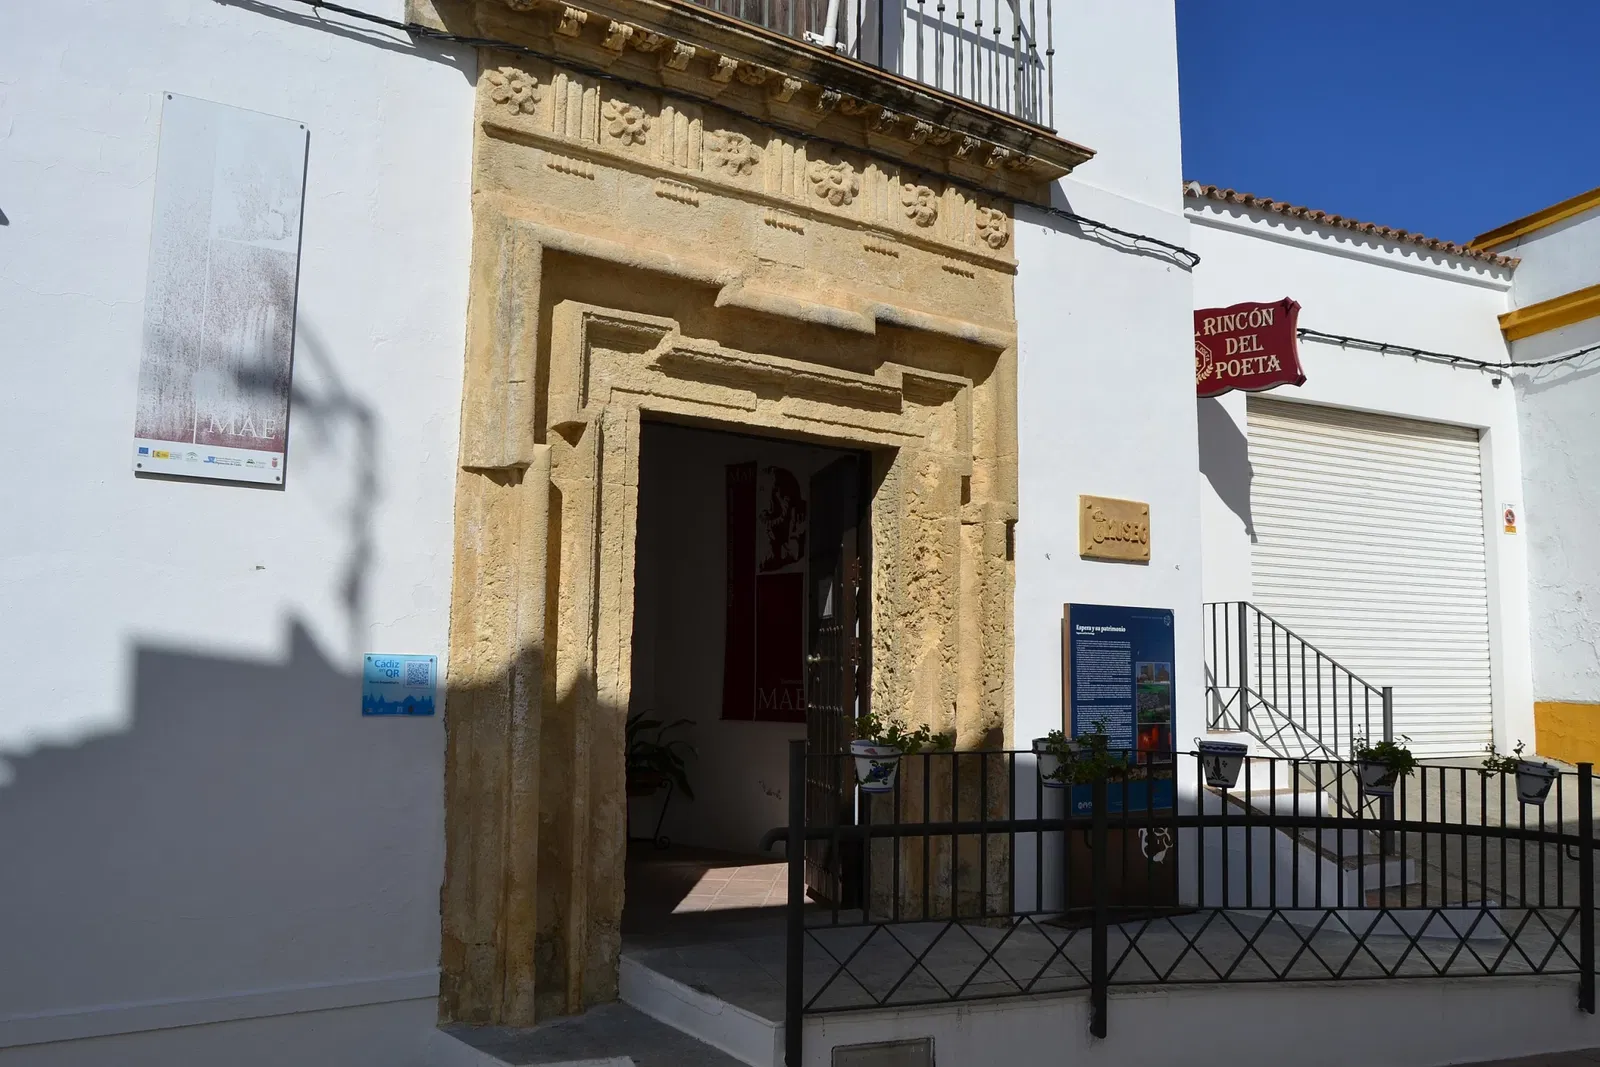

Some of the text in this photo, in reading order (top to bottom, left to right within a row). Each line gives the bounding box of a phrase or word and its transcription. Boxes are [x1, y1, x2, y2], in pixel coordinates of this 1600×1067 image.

[1203, 307, 1275, 336] RINCÓN
[1225, 334, 1264, 355] DEL
[1215, 355, 1282, 379] POETA
[208, 416, 276, 440] MAE
[1104, 519, 1147, 544] MUSEO
[1076, 624, 1091, 632] Espera
[1101, 625, 1126, 633] patrimonio
[375, 659, 399, 668] Cádiz
[386, 669, 400, 678] QR
